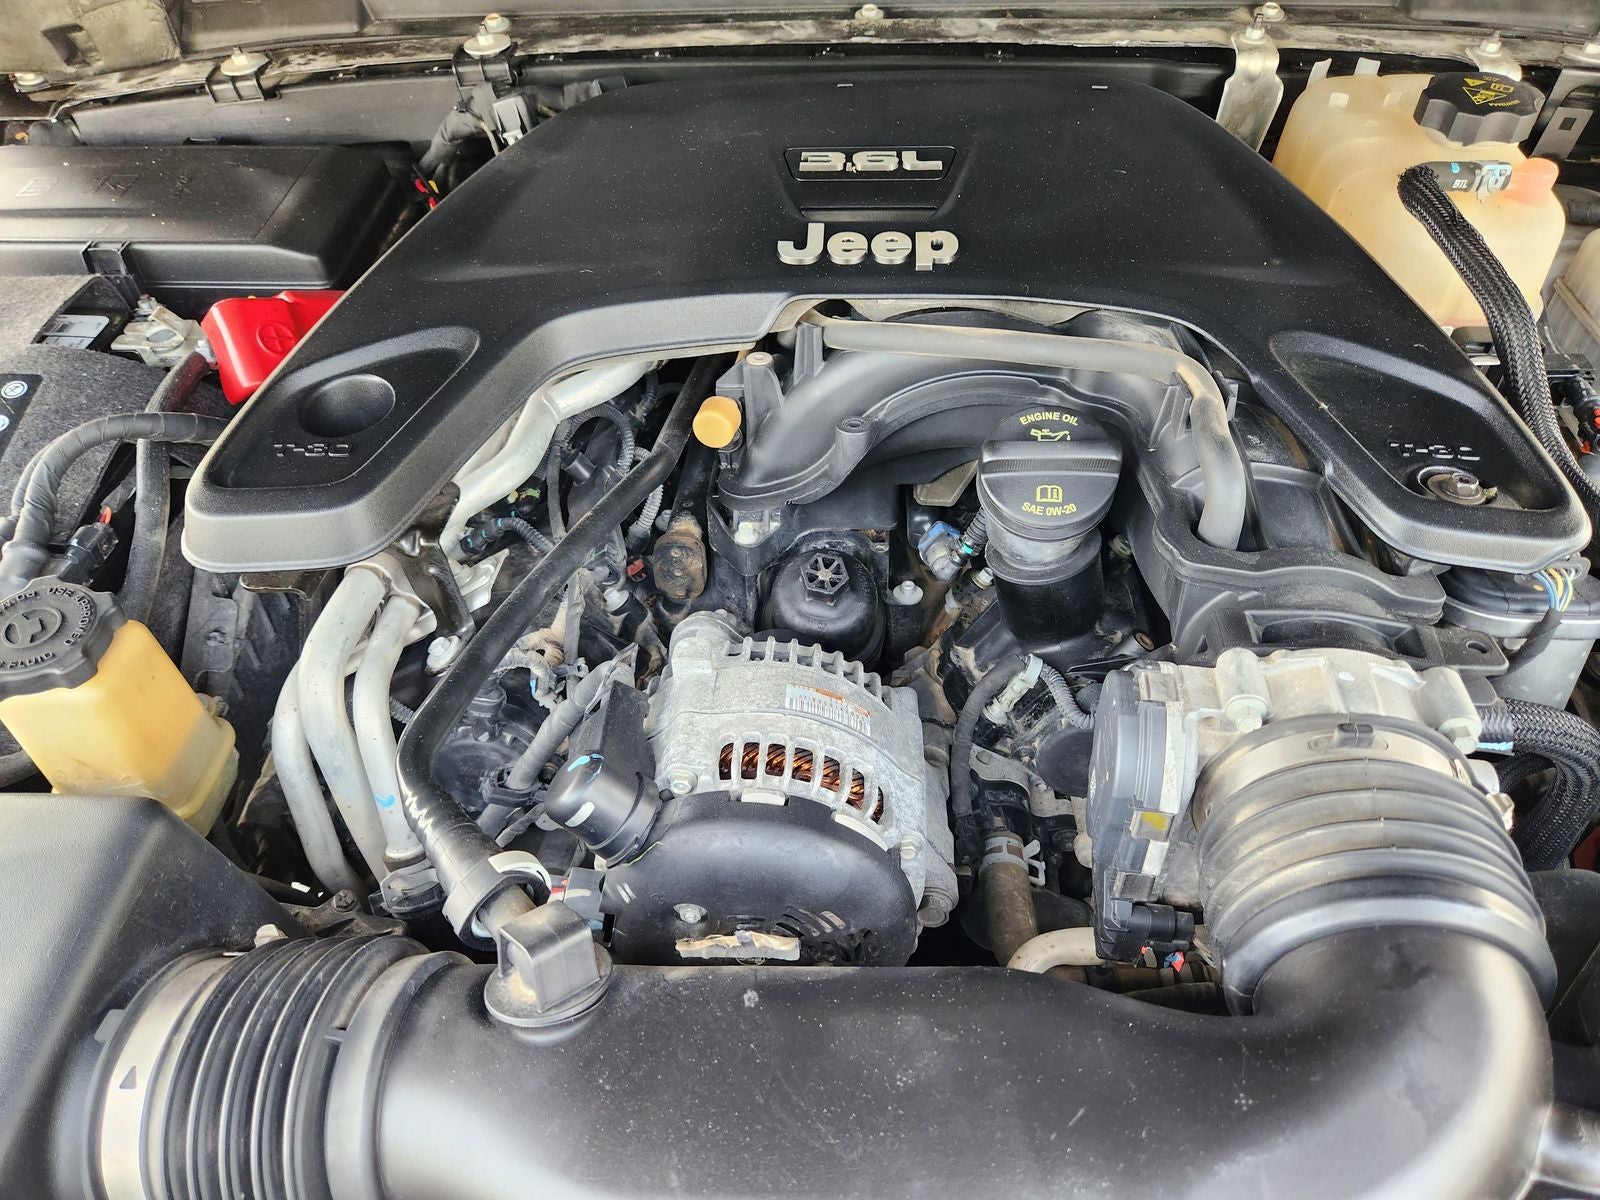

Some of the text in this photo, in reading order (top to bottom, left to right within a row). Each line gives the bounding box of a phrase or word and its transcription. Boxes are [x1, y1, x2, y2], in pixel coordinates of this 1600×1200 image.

[798, 150, 943, 172] 3.6L
[777, 222, 959, 271] Jeep
[1019, 411, 1079, 426] ENGINE OIL
[1022, 502, 1077, 516] SAE 0W-20
[47, 586, 93, 646] USE APPROVED
[8, 652, 56, 669] FLUID
